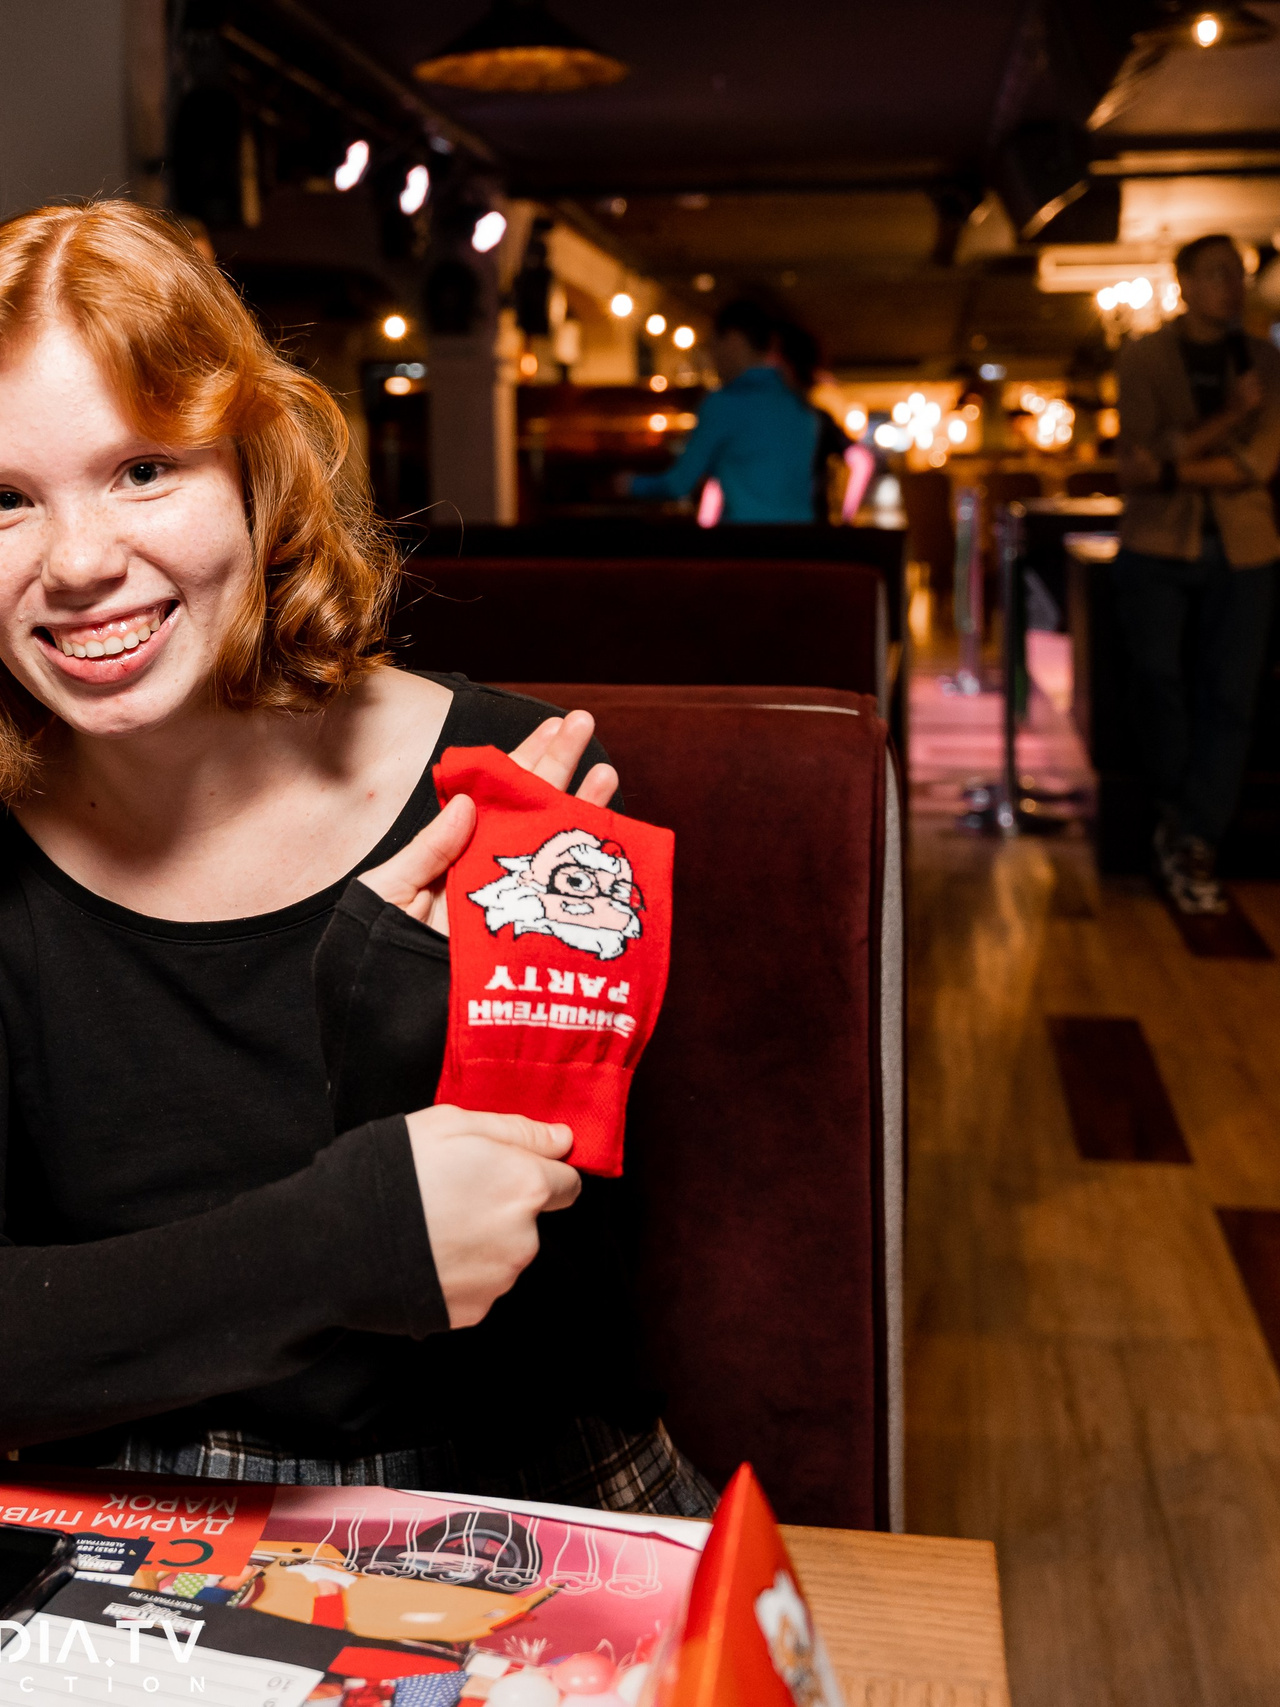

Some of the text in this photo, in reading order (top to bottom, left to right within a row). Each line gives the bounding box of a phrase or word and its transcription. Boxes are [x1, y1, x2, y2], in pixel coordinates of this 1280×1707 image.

[484, 965, 630, 1003] PARTY
[102, 1493, 239, 1517] МАРОК
[91, 1513, 234, 1536] ДАРИМ
[76, 1539, 126, 1548] ALBERTPART
[127, 1591, 204, 1613] ALBERTPARTY.RU
